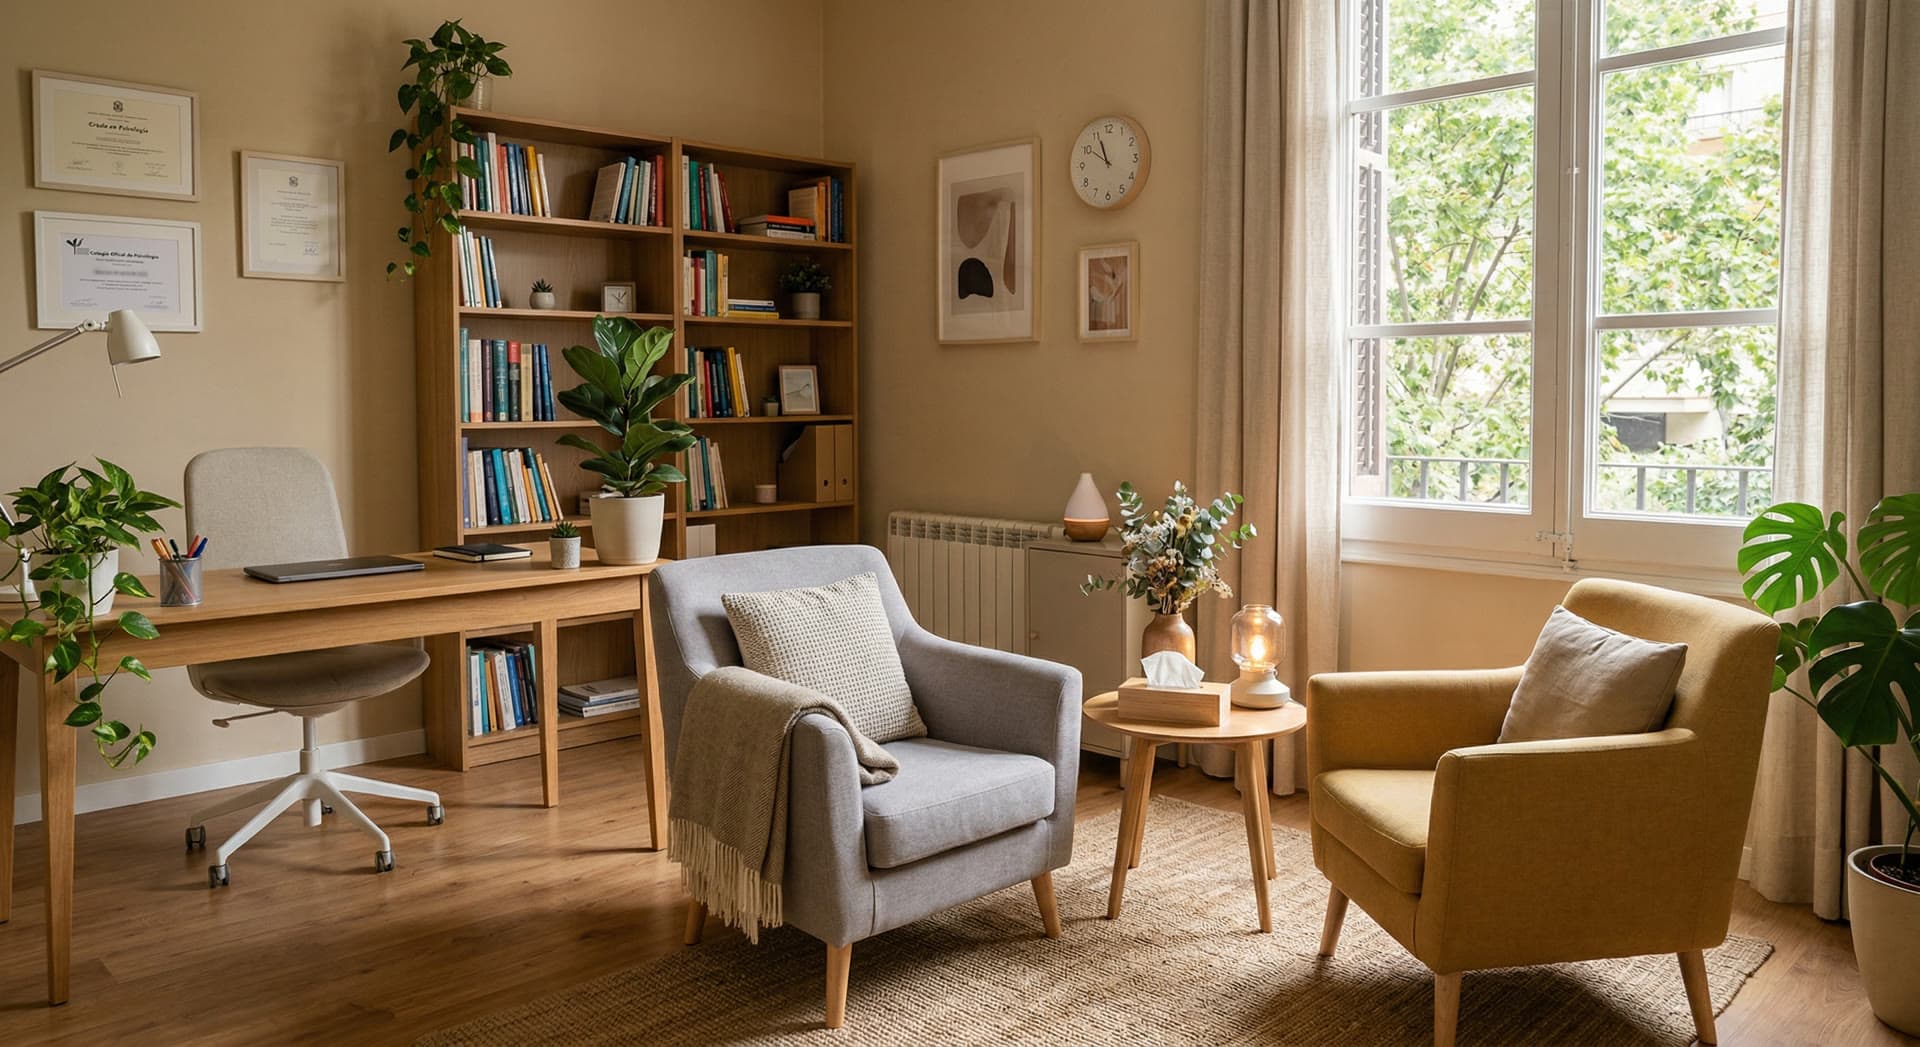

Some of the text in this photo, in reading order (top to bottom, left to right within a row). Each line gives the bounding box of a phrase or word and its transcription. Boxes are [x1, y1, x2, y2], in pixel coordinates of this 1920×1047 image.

[1104, 124, 1114, 134] 12
[1093, 131, 1100, 140] 11
[1128, 136, 1135, 147] 2
[1083, 144, 1092, 155] 10
[1132, 153, 1139, 163] 3
[1079, 162, 1085, 170] 9
[1128, 171, 1135, 180] 4
[1083, 177, 1089, 187] 8
[1092, 187, 1098, 198] 7
[1119, 184, 1125, 194] 5
[1105, 190, 1111, 201] 6
